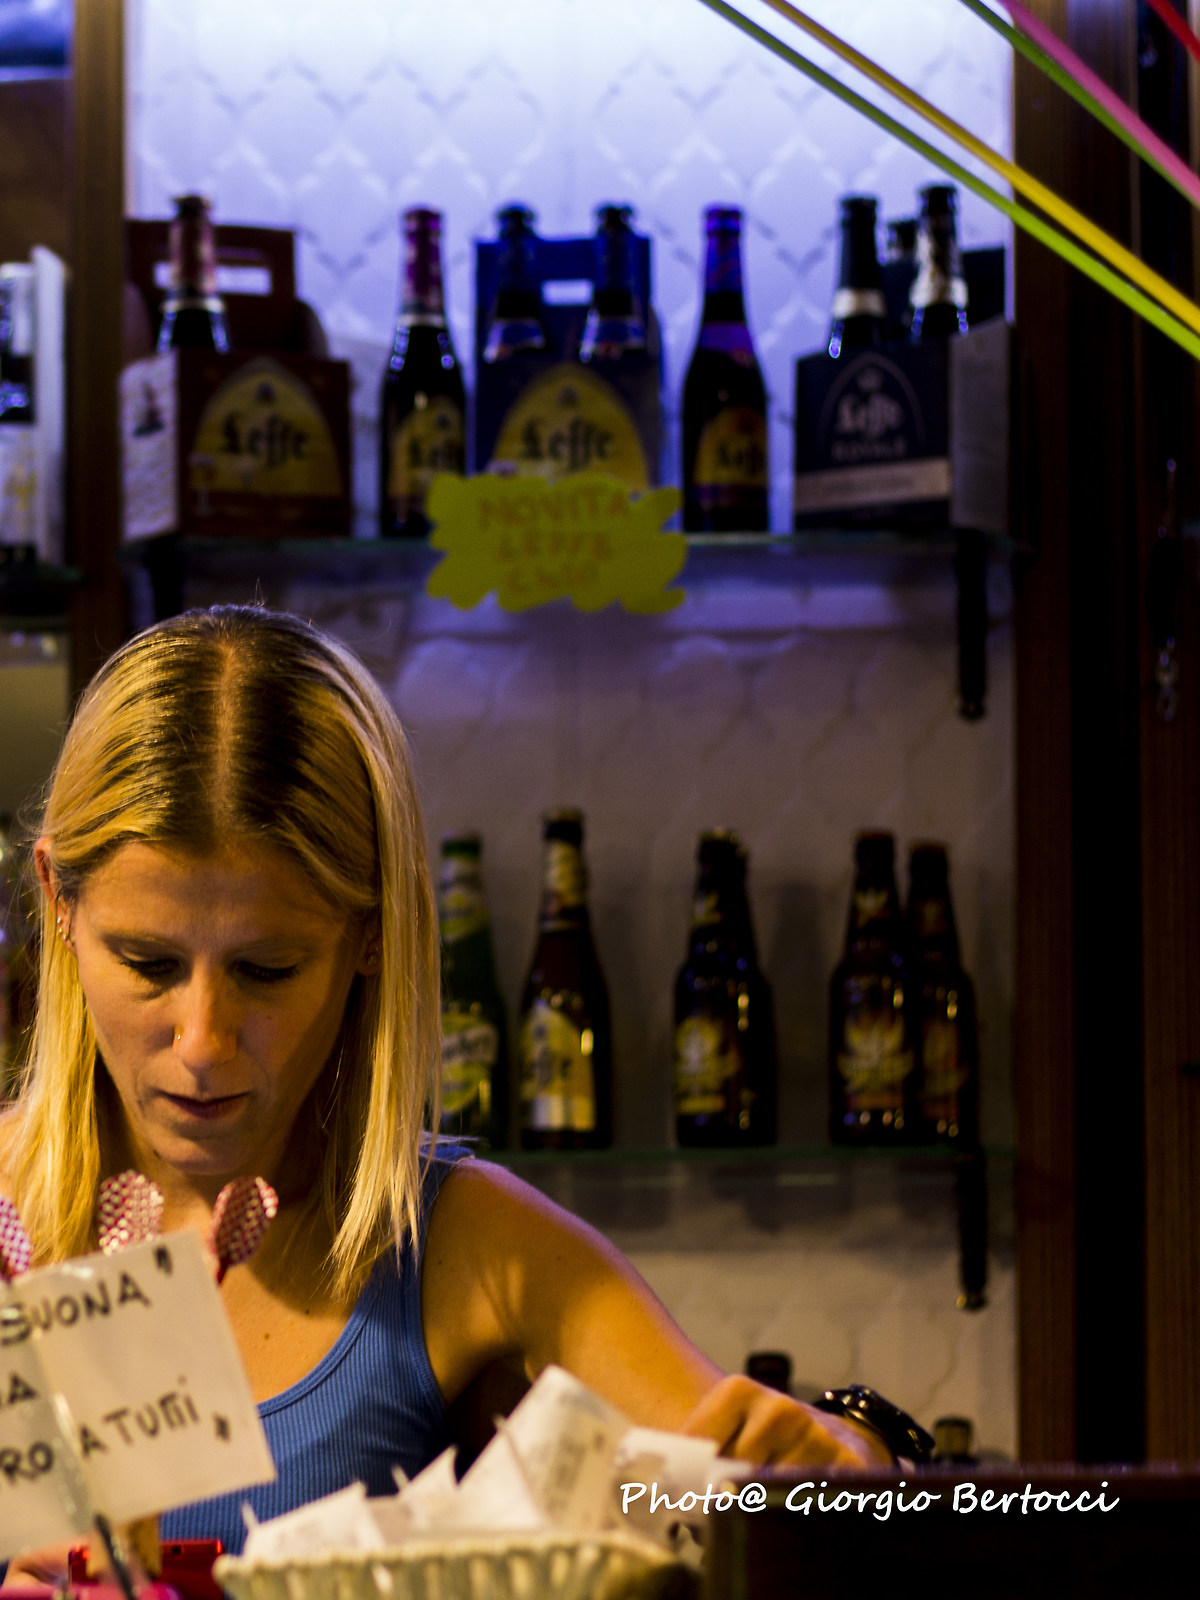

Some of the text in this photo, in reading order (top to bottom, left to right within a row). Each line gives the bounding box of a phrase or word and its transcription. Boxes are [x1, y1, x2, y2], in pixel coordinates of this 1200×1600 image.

[221, 410, 310, 470] Leffe
[522, 416, 613, 472] Leffe
[78, 1422, 110, 1459] A
